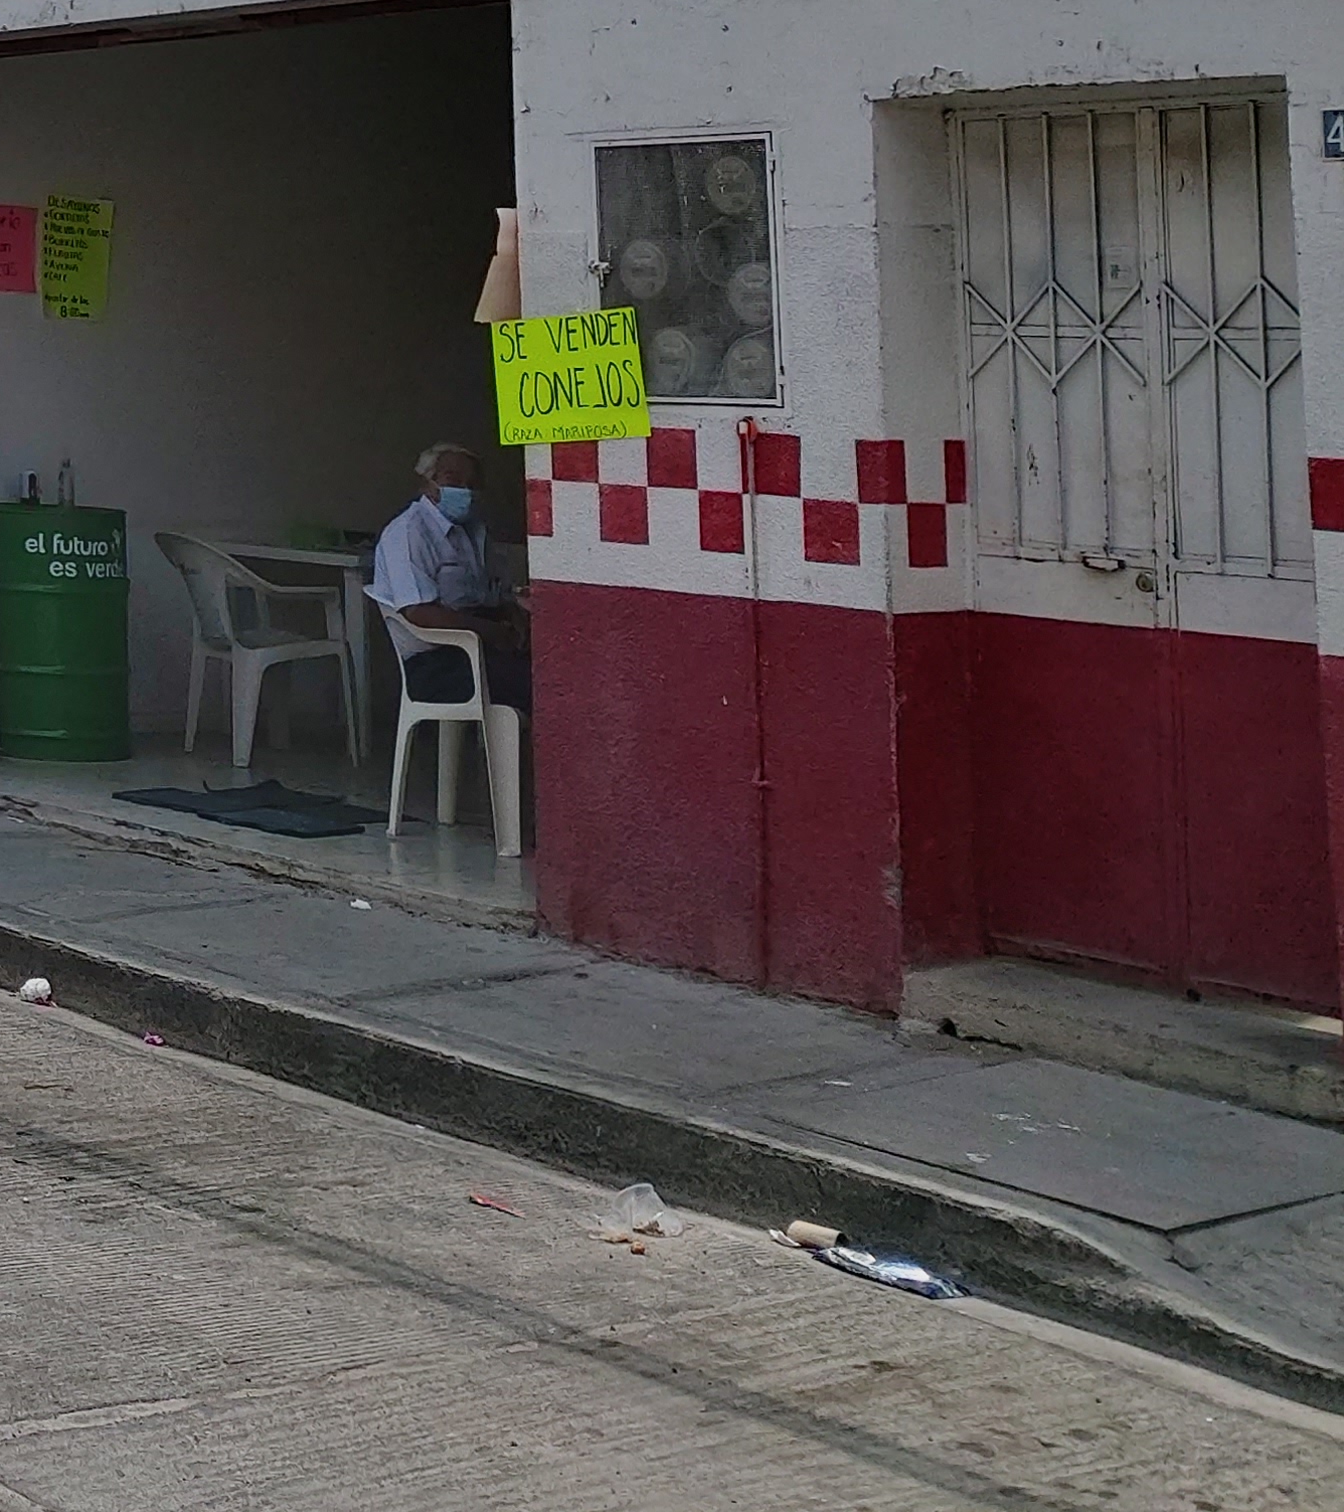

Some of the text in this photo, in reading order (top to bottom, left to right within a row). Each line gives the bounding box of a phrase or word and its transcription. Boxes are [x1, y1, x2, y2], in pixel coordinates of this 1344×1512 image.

[499, 309, 638, 363] SE VENDEN
[519, 359, 641, 418] CONEJOS
[503, 419, 628, 443] (RAZA MARIPOSA)
[24, 532, 109, 556] el futuro
[48, 560, 78, 578] es
